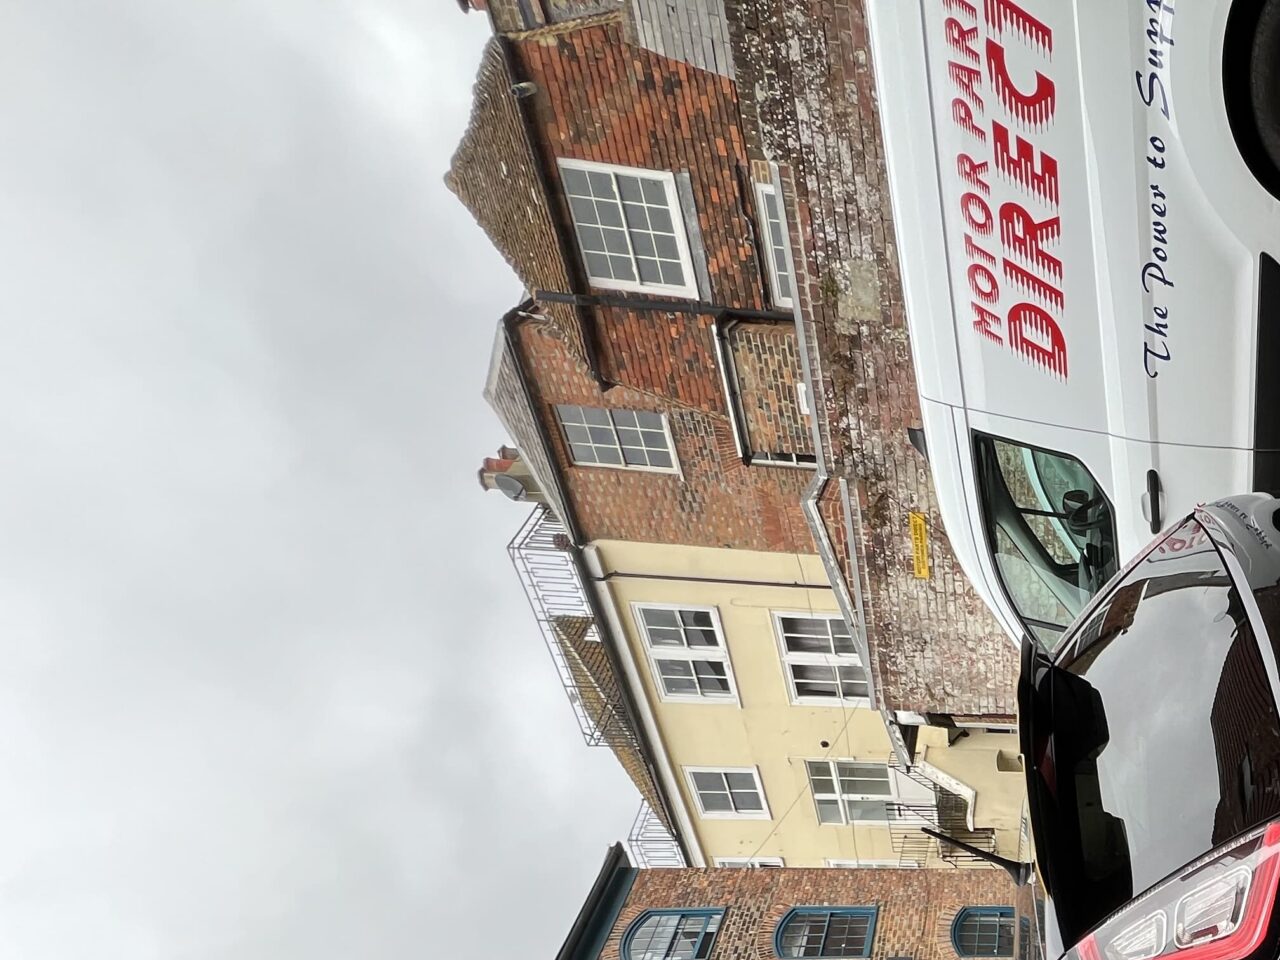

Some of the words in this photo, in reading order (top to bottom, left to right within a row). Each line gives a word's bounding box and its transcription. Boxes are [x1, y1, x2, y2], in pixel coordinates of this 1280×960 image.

[984, 0, 1067, 384] DIRECT
[1149, 135, 1166, 169] to
[956, 152, 1003, 346] MOTOR
[1141, 184, 1174, 293] Power
[1143, 306, 1172, 378] The
